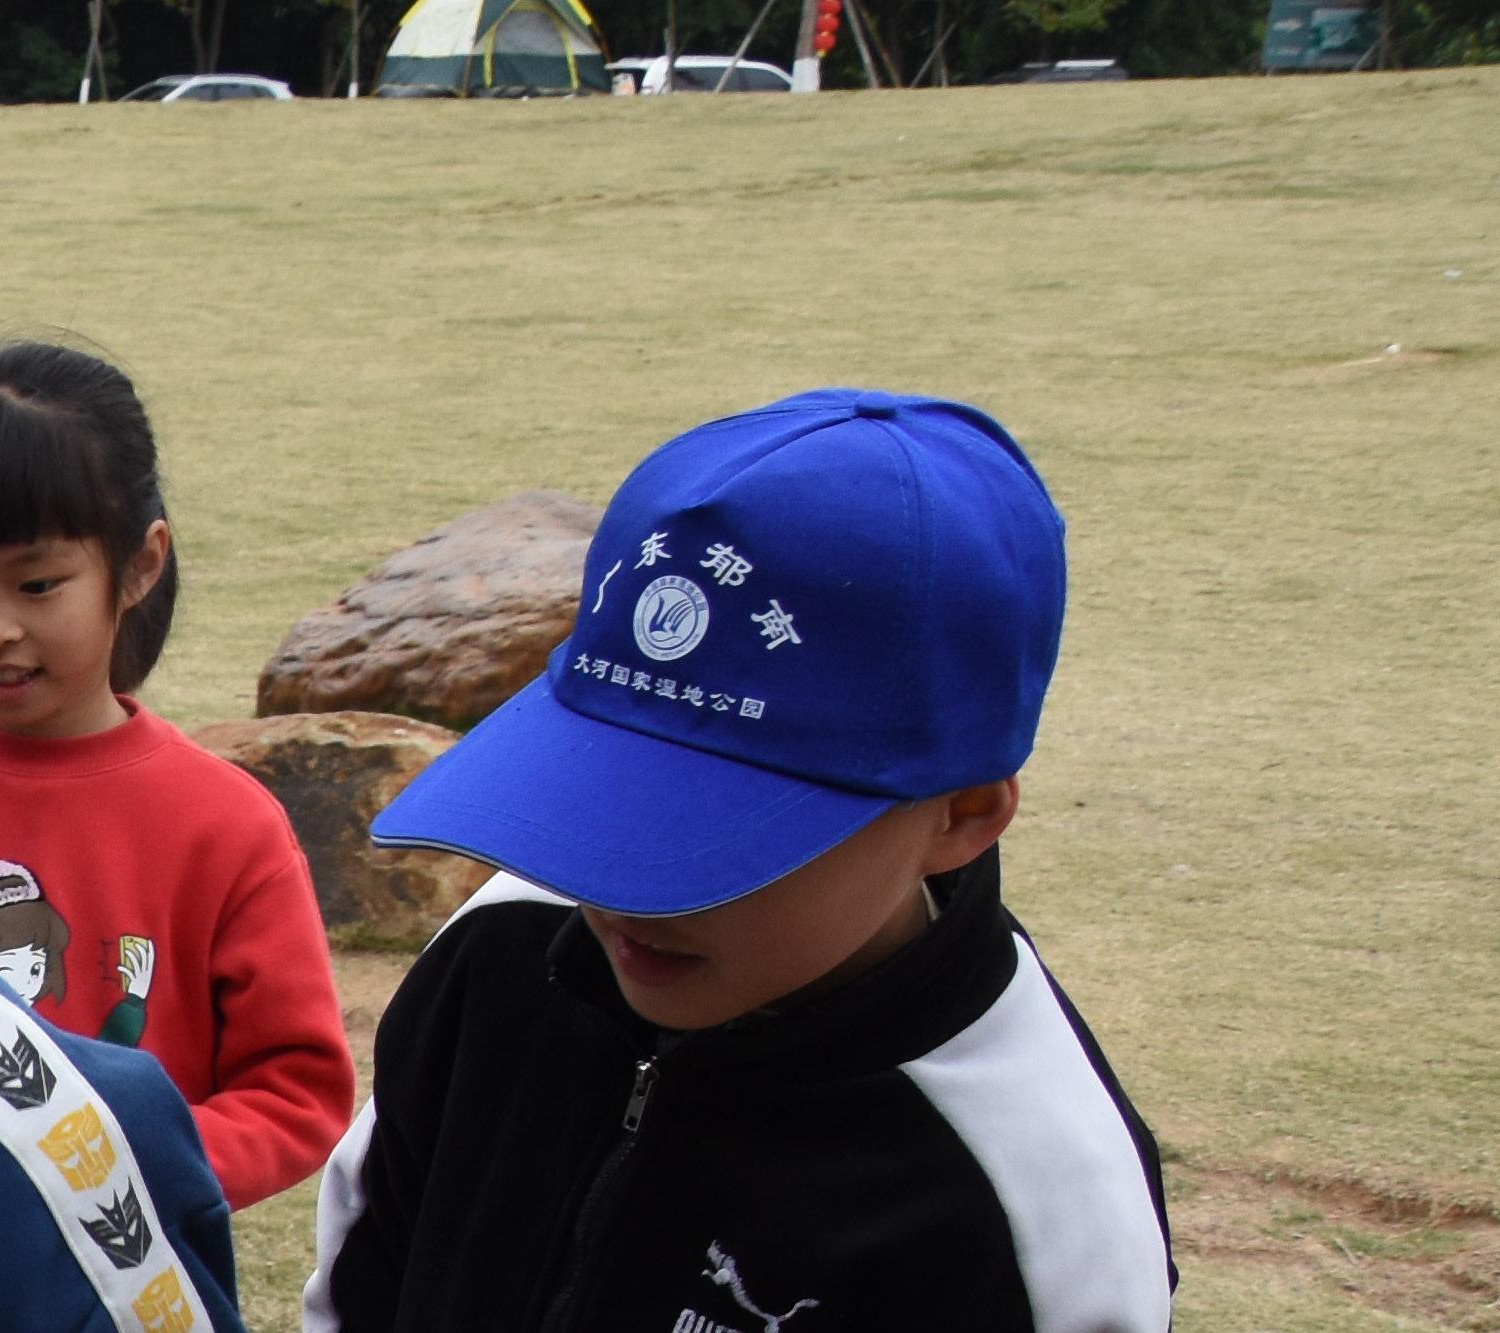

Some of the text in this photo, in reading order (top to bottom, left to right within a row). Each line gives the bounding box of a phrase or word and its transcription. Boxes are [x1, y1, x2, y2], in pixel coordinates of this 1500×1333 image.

[574, 653, 766, 720] 大河国家湿地公园
